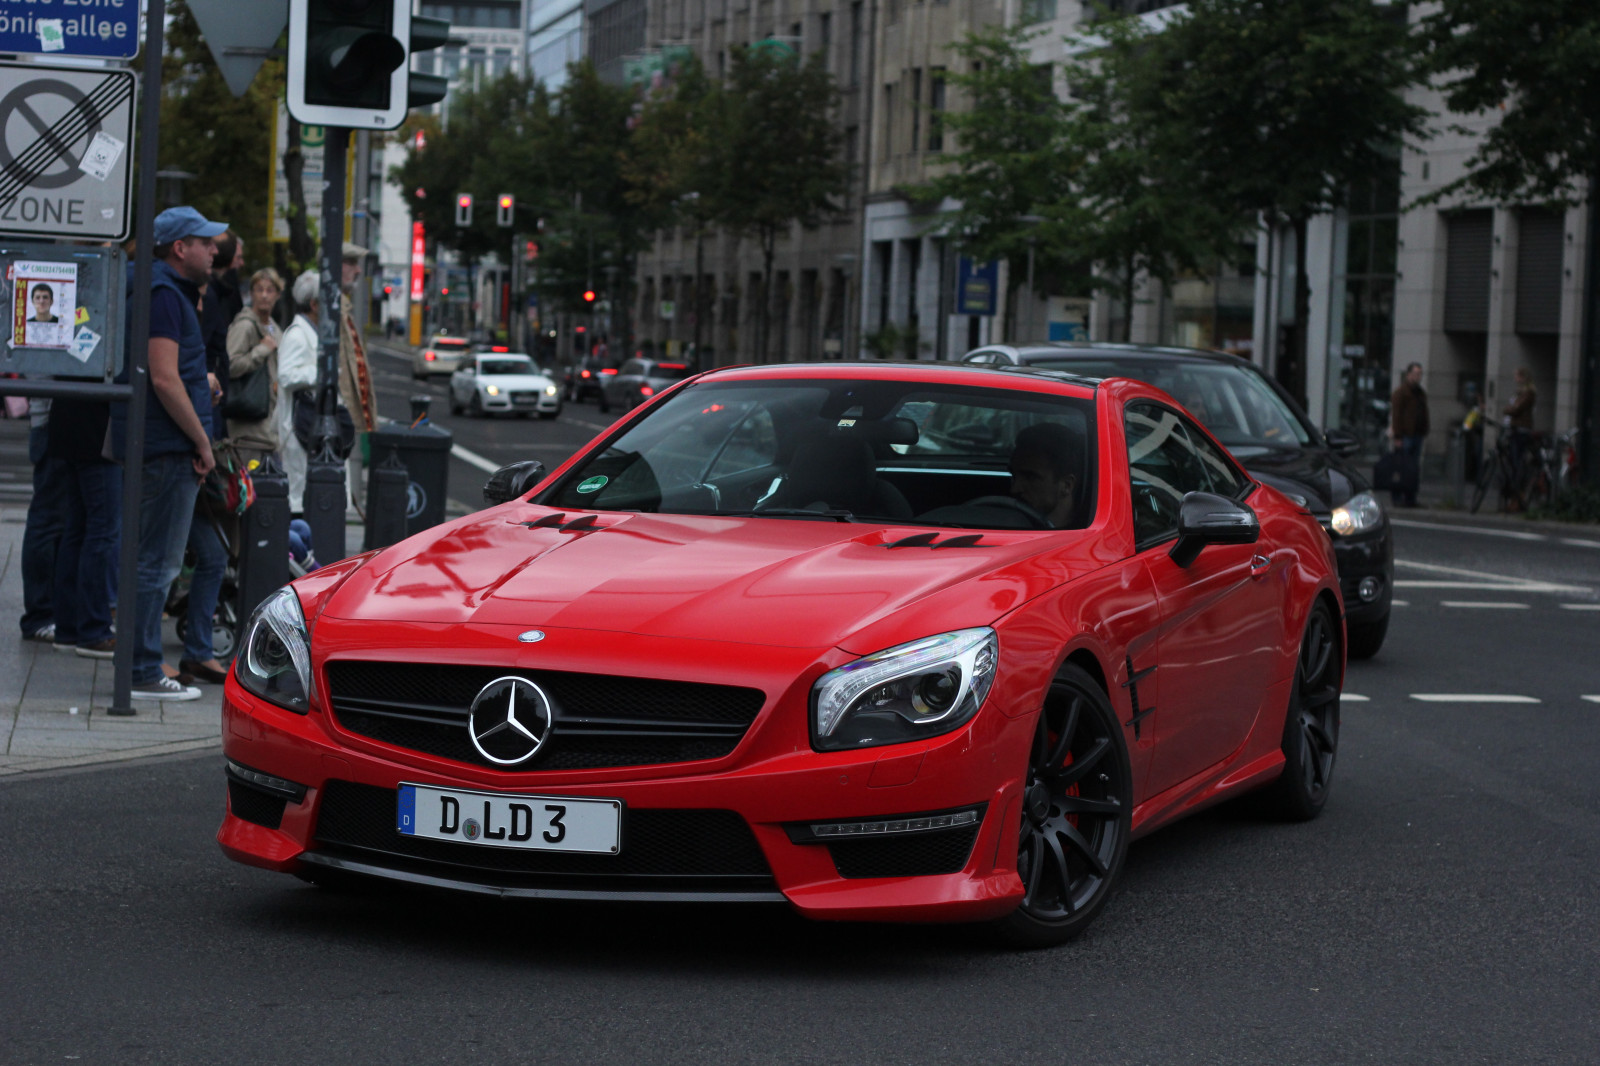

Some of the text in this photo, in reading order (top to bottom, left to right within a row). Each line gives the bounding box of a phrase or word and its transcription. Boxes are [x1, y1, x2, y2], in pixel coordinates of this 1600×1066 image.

[1, 196, 84, 225] ZONE
[14, 280, 27, 344] MISSING
[403, 814, 410, 826] D
[440, 795, 567, 844] D LD 3
